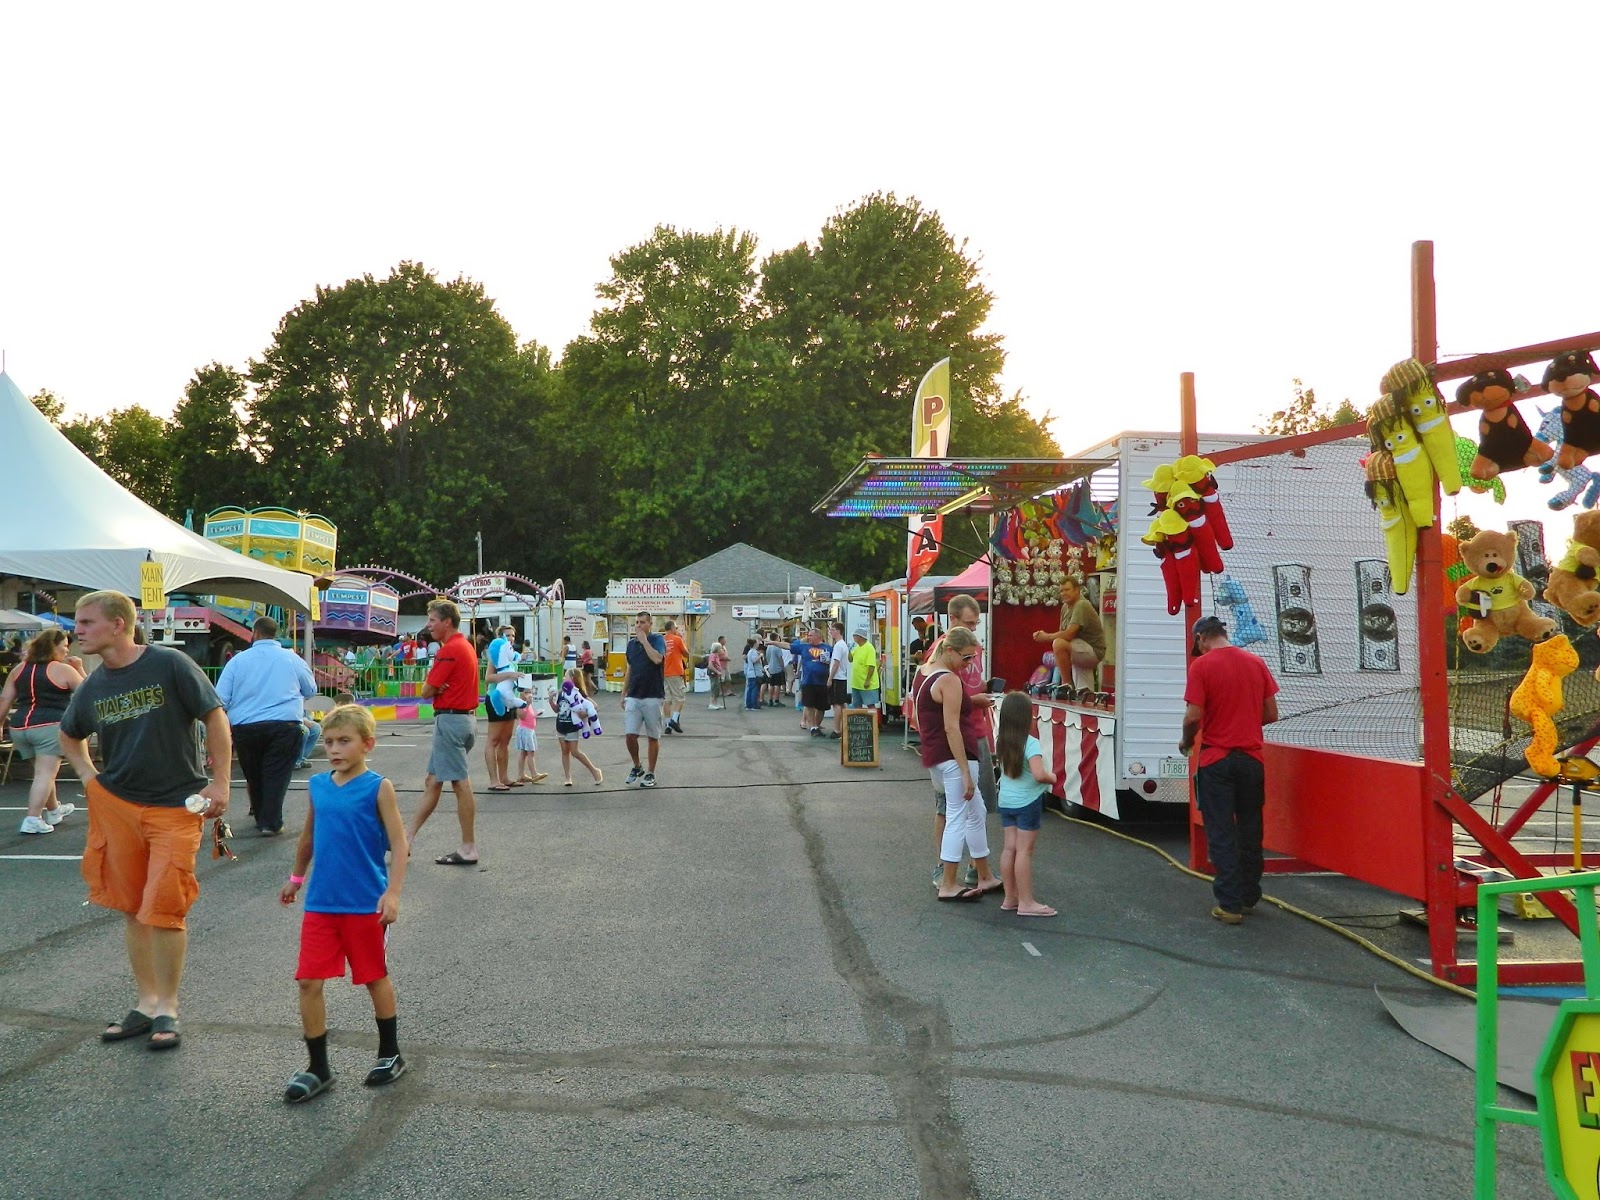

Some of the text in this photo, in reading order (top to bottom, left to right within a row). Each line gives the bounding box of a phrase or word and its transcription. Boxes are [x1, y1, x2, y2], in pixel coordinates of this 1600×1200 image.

[210, 523, 241, 534] TEMPEST
[141, 567, 163, 583] MAIN
[472, 578, 492, 587] GYROS
[626, 583, 670, 594] FRENCH FRIES
[142, 587, 163, 602] TENT
[331, 592, 365, 600] TEMPEST
